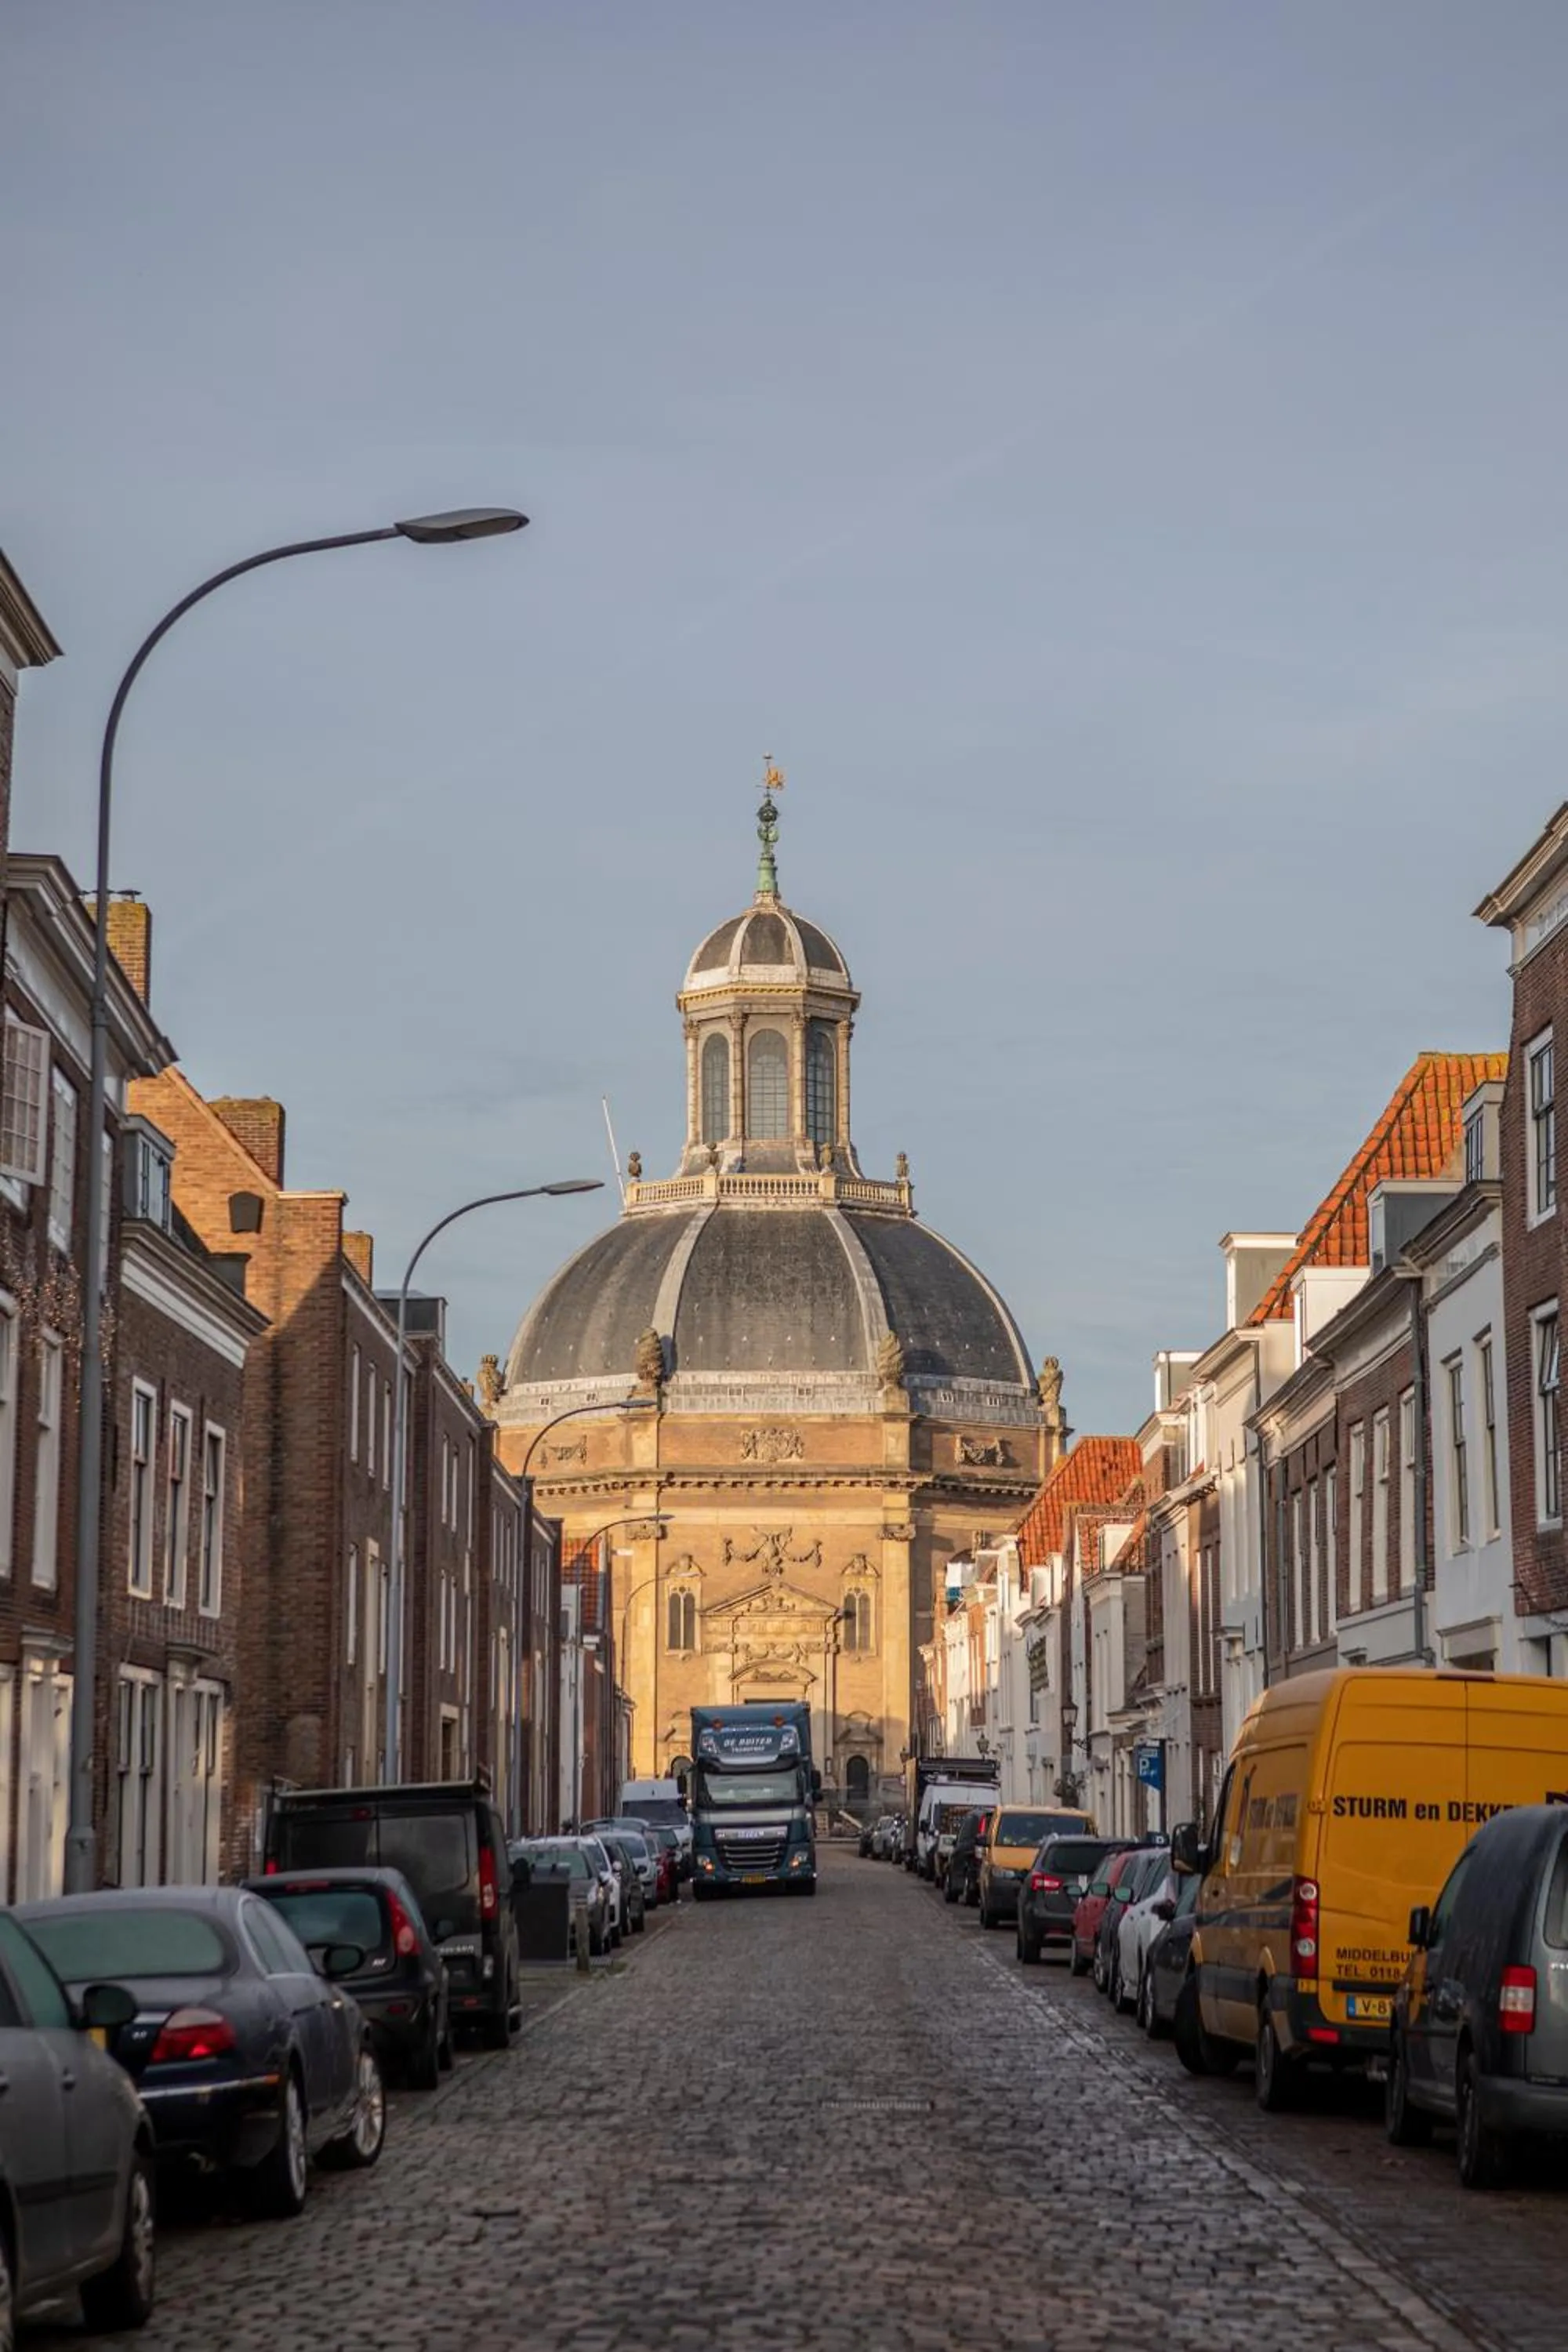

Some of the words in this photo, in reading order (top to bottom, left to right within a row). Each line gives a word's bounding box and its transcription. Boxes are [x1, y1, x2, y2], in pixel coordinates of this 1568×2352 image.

[1333, 1795, 1407, 1820] STURM
[1414, 1802, 1441, 1821] en
[1447, 1800, 1515, 1823] DEKK
[1336, 1947, 1413, 1964] MIDDELBU
